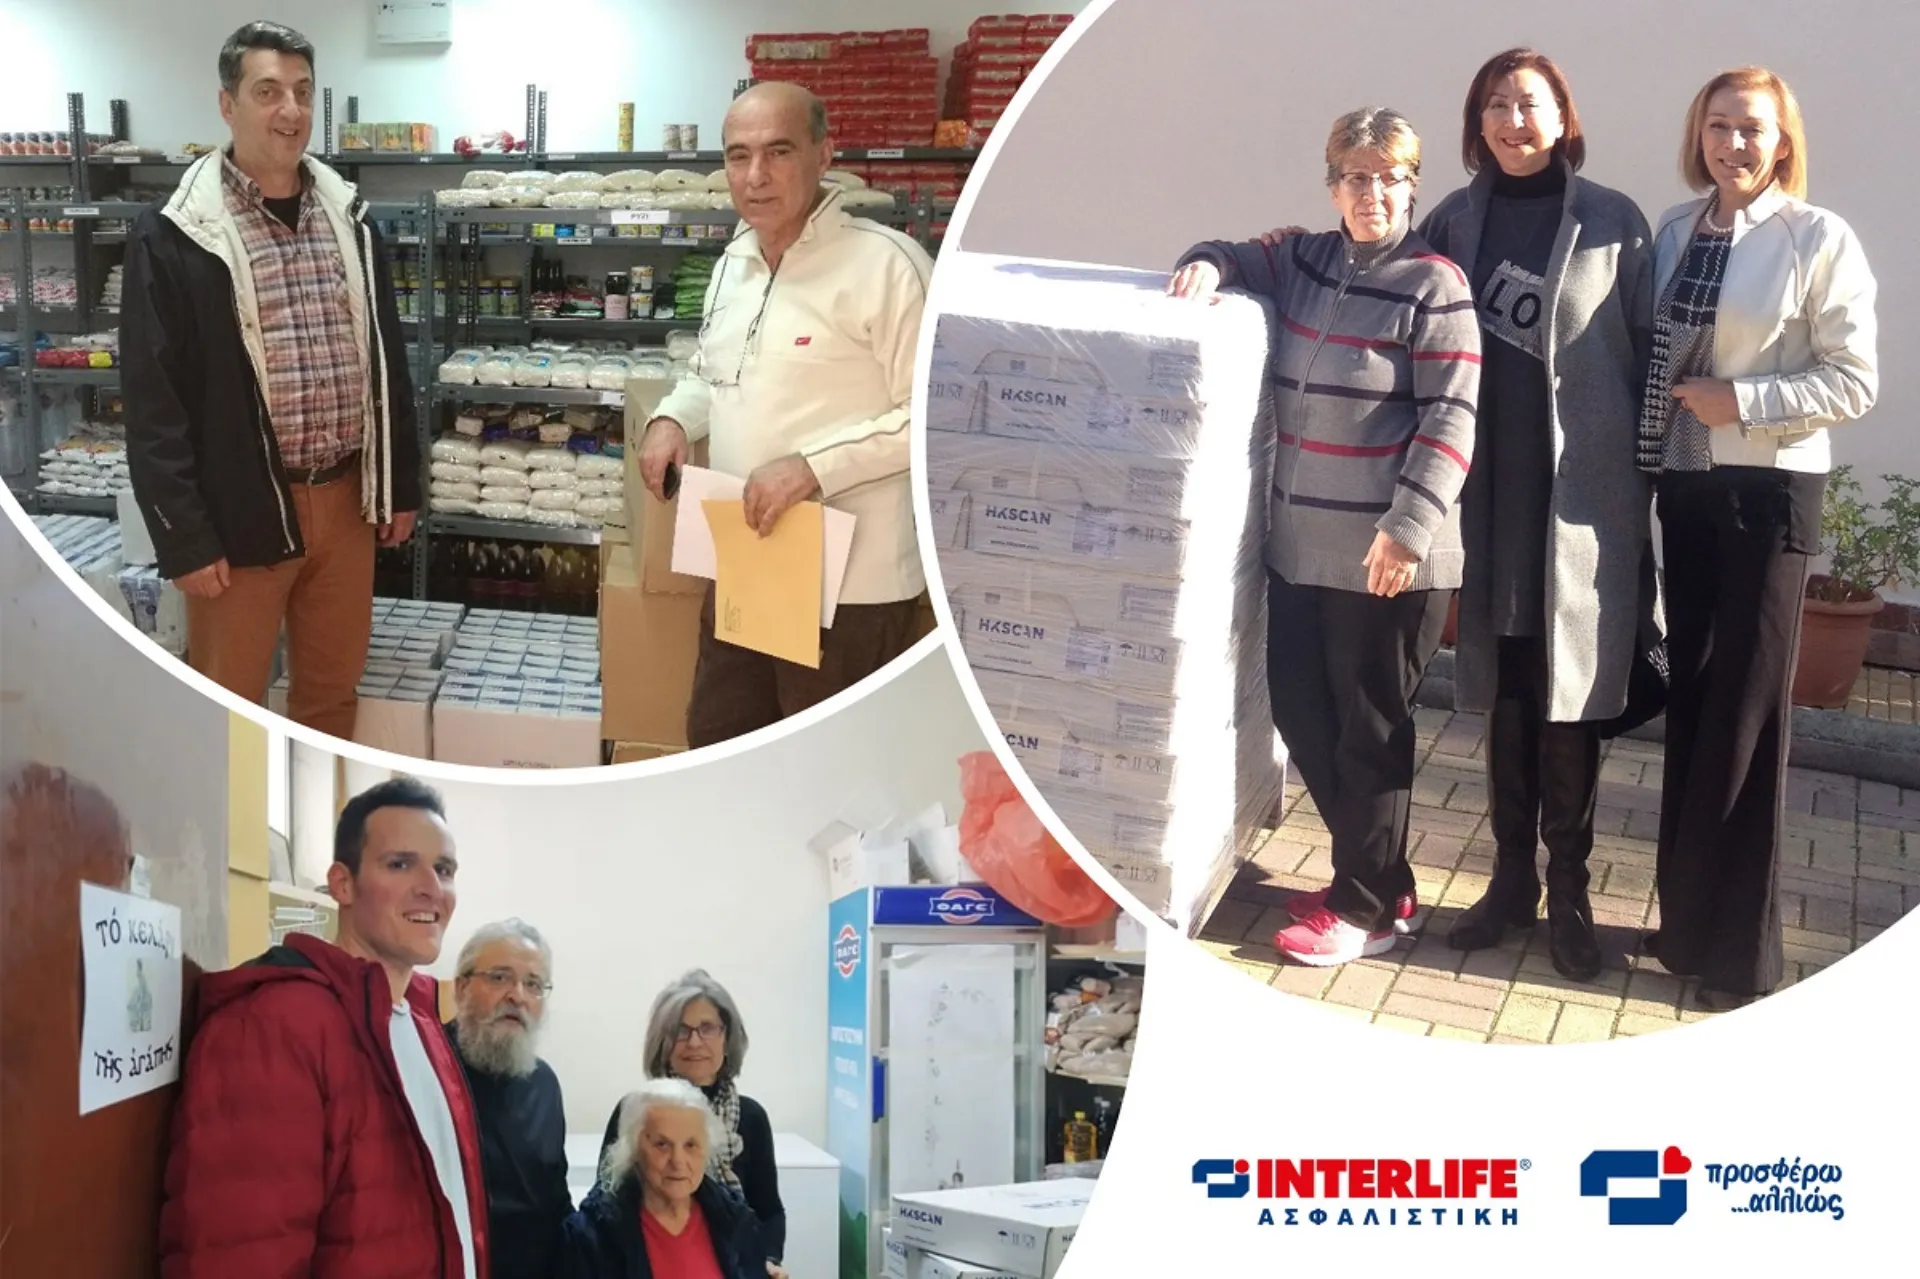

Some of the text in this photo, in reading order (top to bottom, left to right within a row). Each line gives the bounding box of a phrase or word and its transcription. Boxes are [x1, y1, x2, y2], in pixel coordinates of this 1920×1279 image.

[1001, 388, 1067, 407] HKSCAN
[985, 504, 1052, 526] HKSCAN
[978, 617, 1045, 640] HKSCAN
[899, 1206, 944, 1226] HKSCAN
